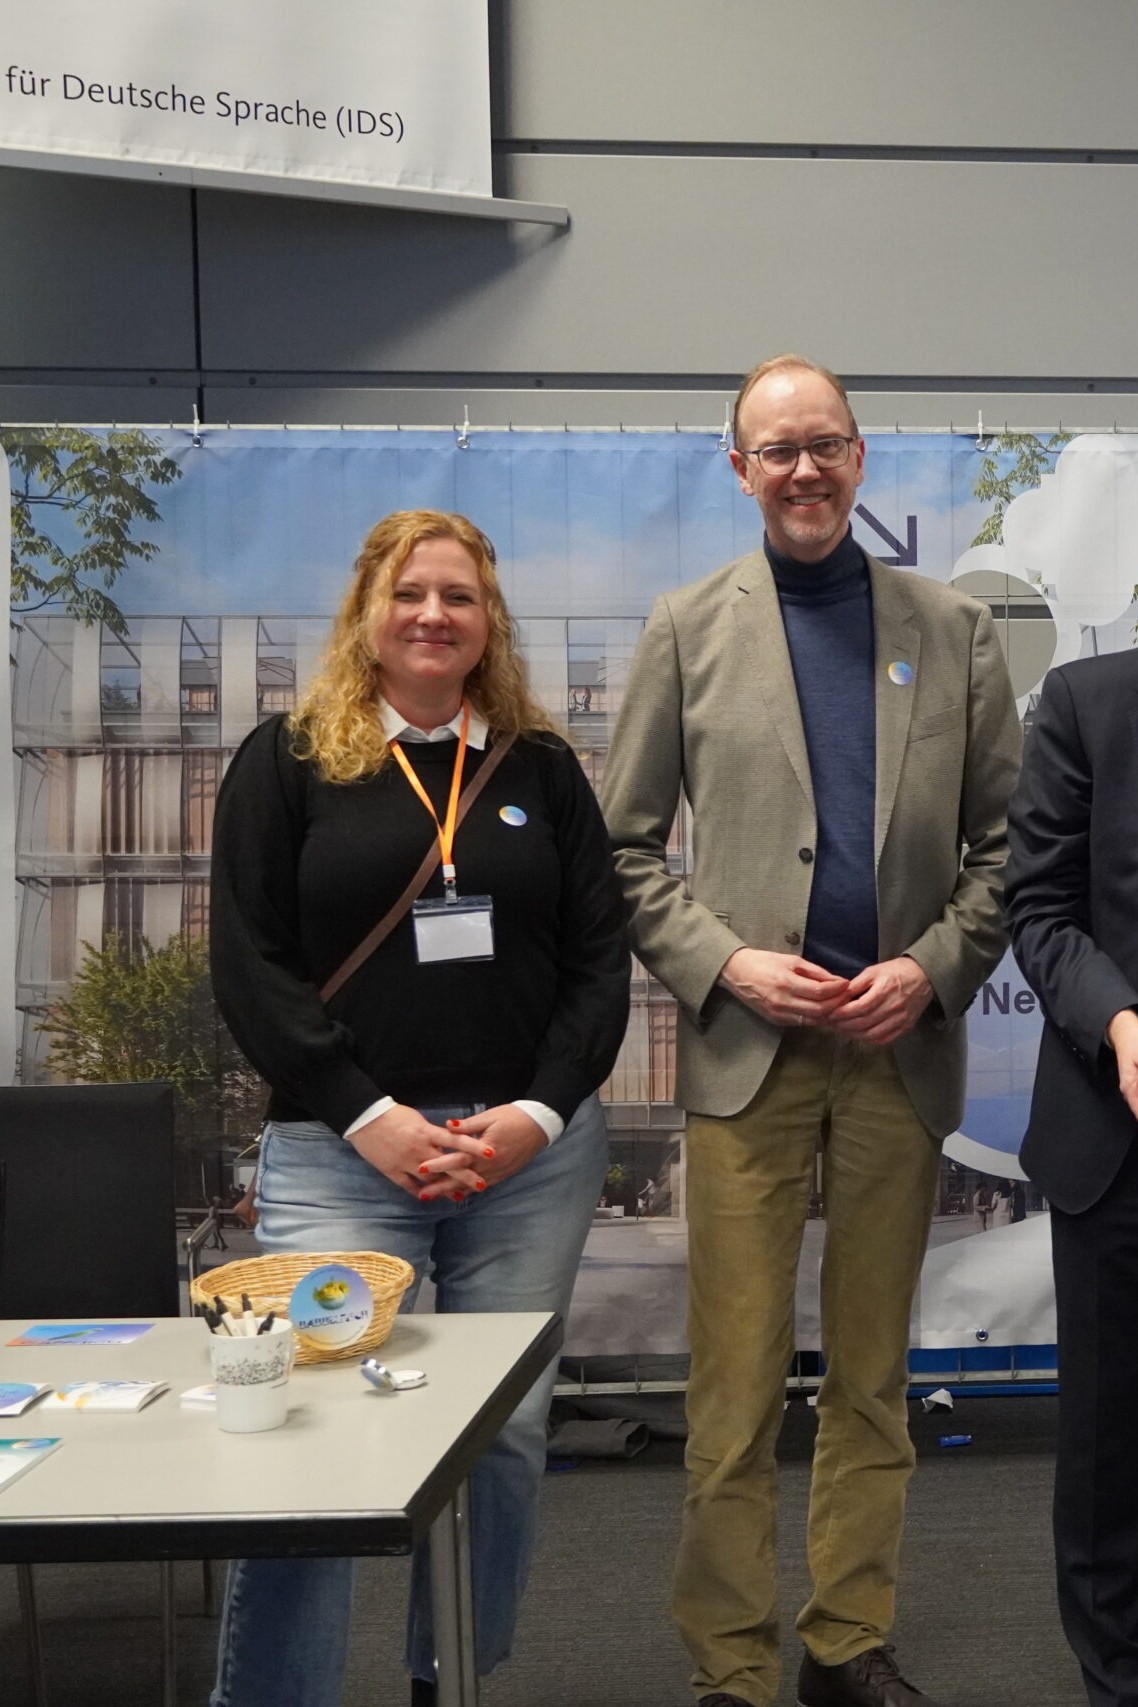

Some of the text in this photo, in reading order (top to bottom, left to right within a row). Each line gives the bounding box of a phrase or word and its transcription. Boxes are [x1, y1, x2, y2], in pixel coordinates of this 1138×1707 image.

[5, 66, 405, 144] für Deutsche Sprache (IDS)
